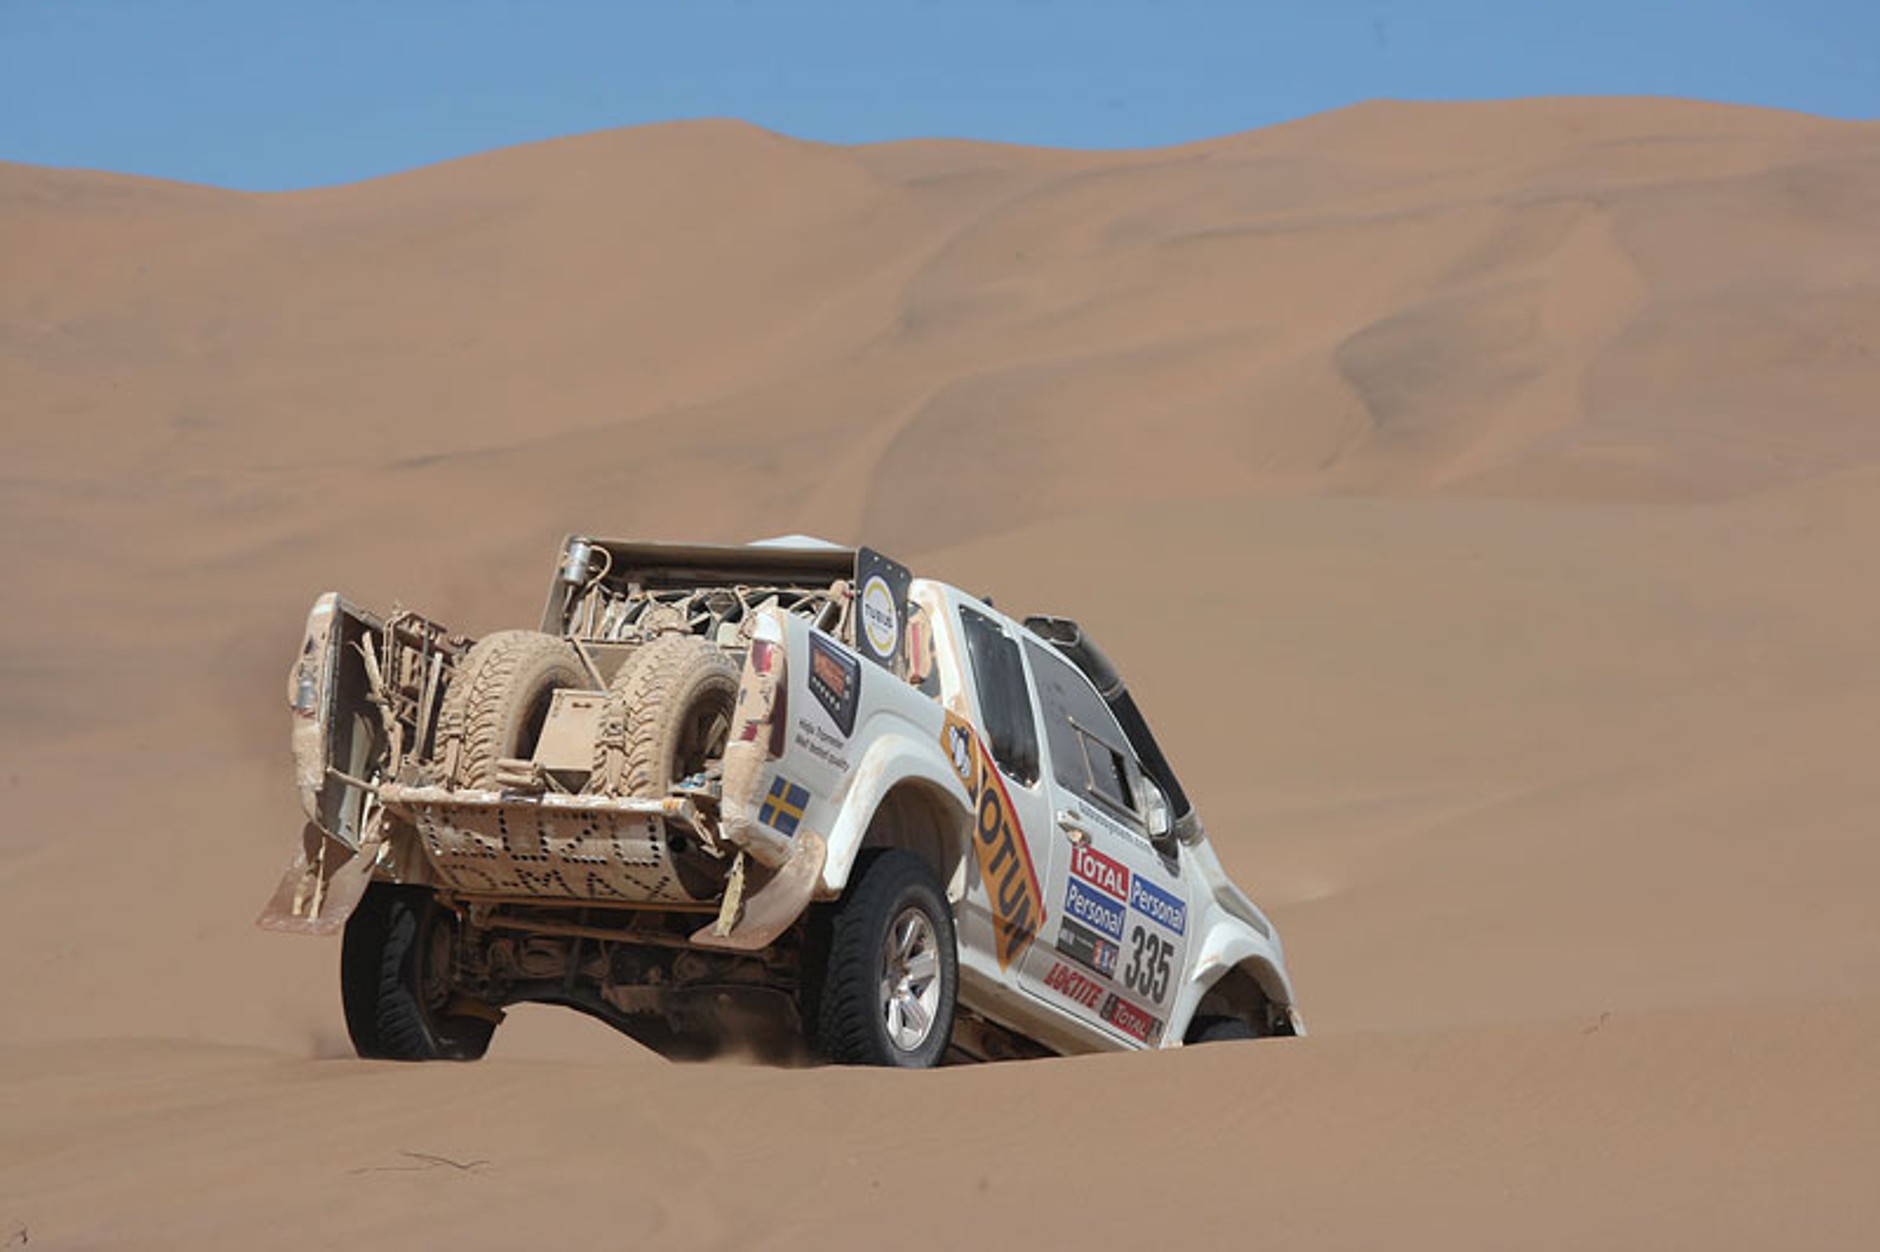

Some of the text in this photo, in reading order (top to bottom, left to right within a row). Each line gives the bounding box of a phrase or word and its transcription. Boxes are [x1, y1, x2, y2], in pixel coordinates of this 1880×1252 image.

[1075, 844, 1126, 897] TOTAL
[1067, 884, 1124, 939] Personal
[1132, 880, 1186, 929] Personal
[1043, 962, 1104, 1009] LOCTITE
[1125, 925, 1174, 1004] 335
[1113, 1003, 1148, 1038] TOTAL
